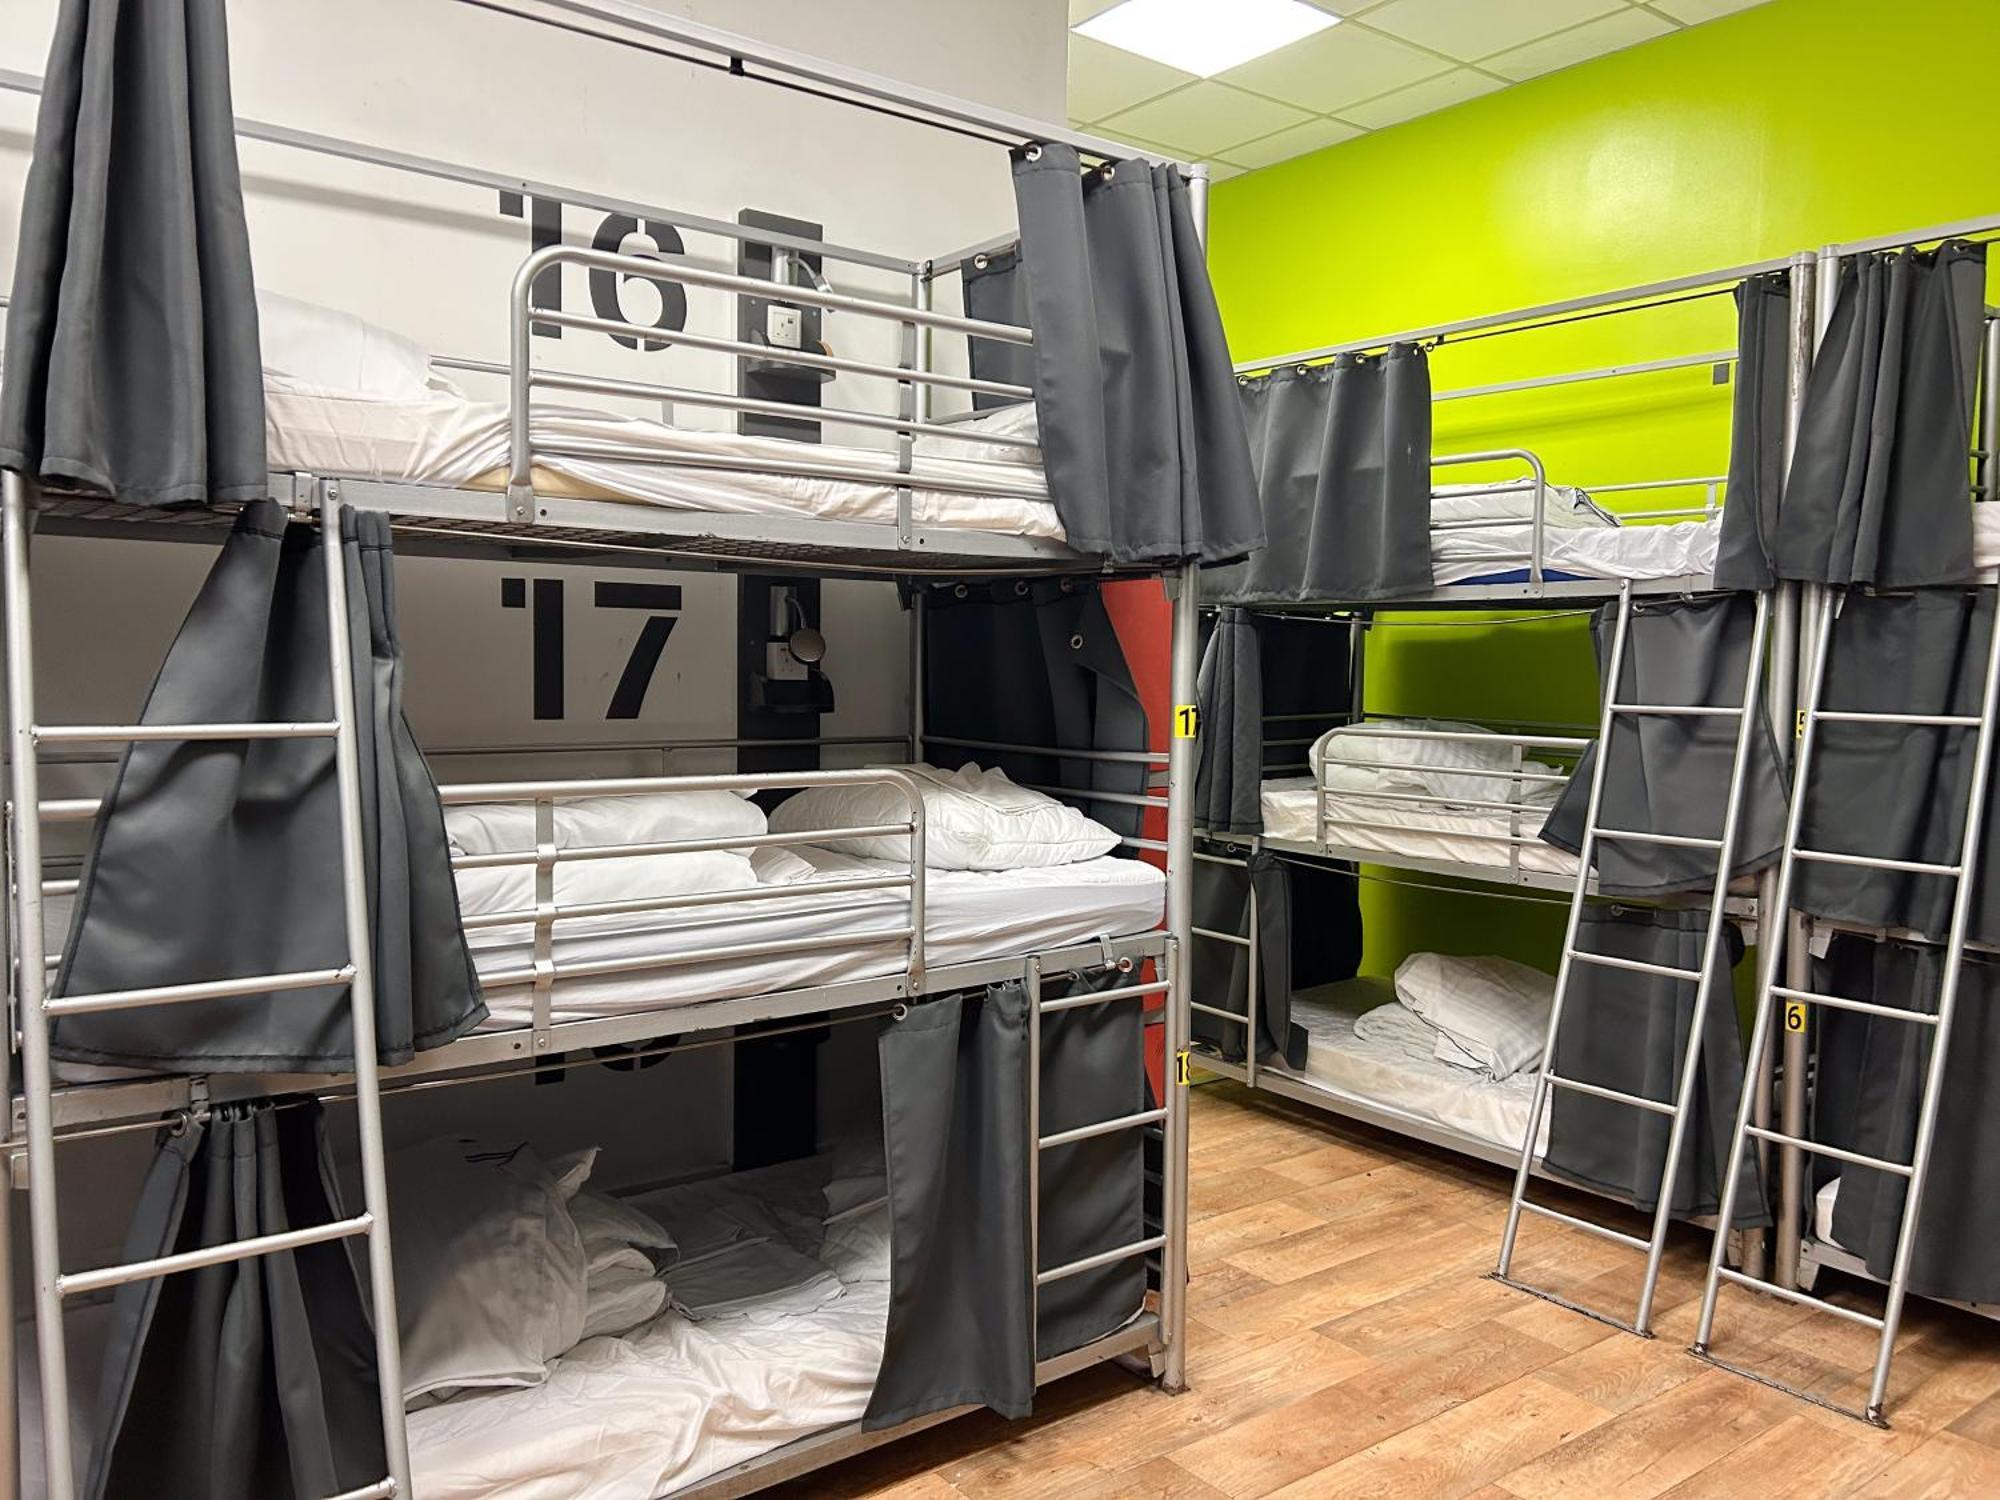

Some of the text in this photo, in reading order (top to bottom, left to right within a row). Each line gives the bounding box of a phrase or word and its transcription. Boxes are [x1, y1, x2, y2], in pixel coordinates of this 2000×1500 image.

[499, 188, 687, 353] 16
[501, 577, 682, 720] 17
[1787, 1005, 1802, 1030] 6
